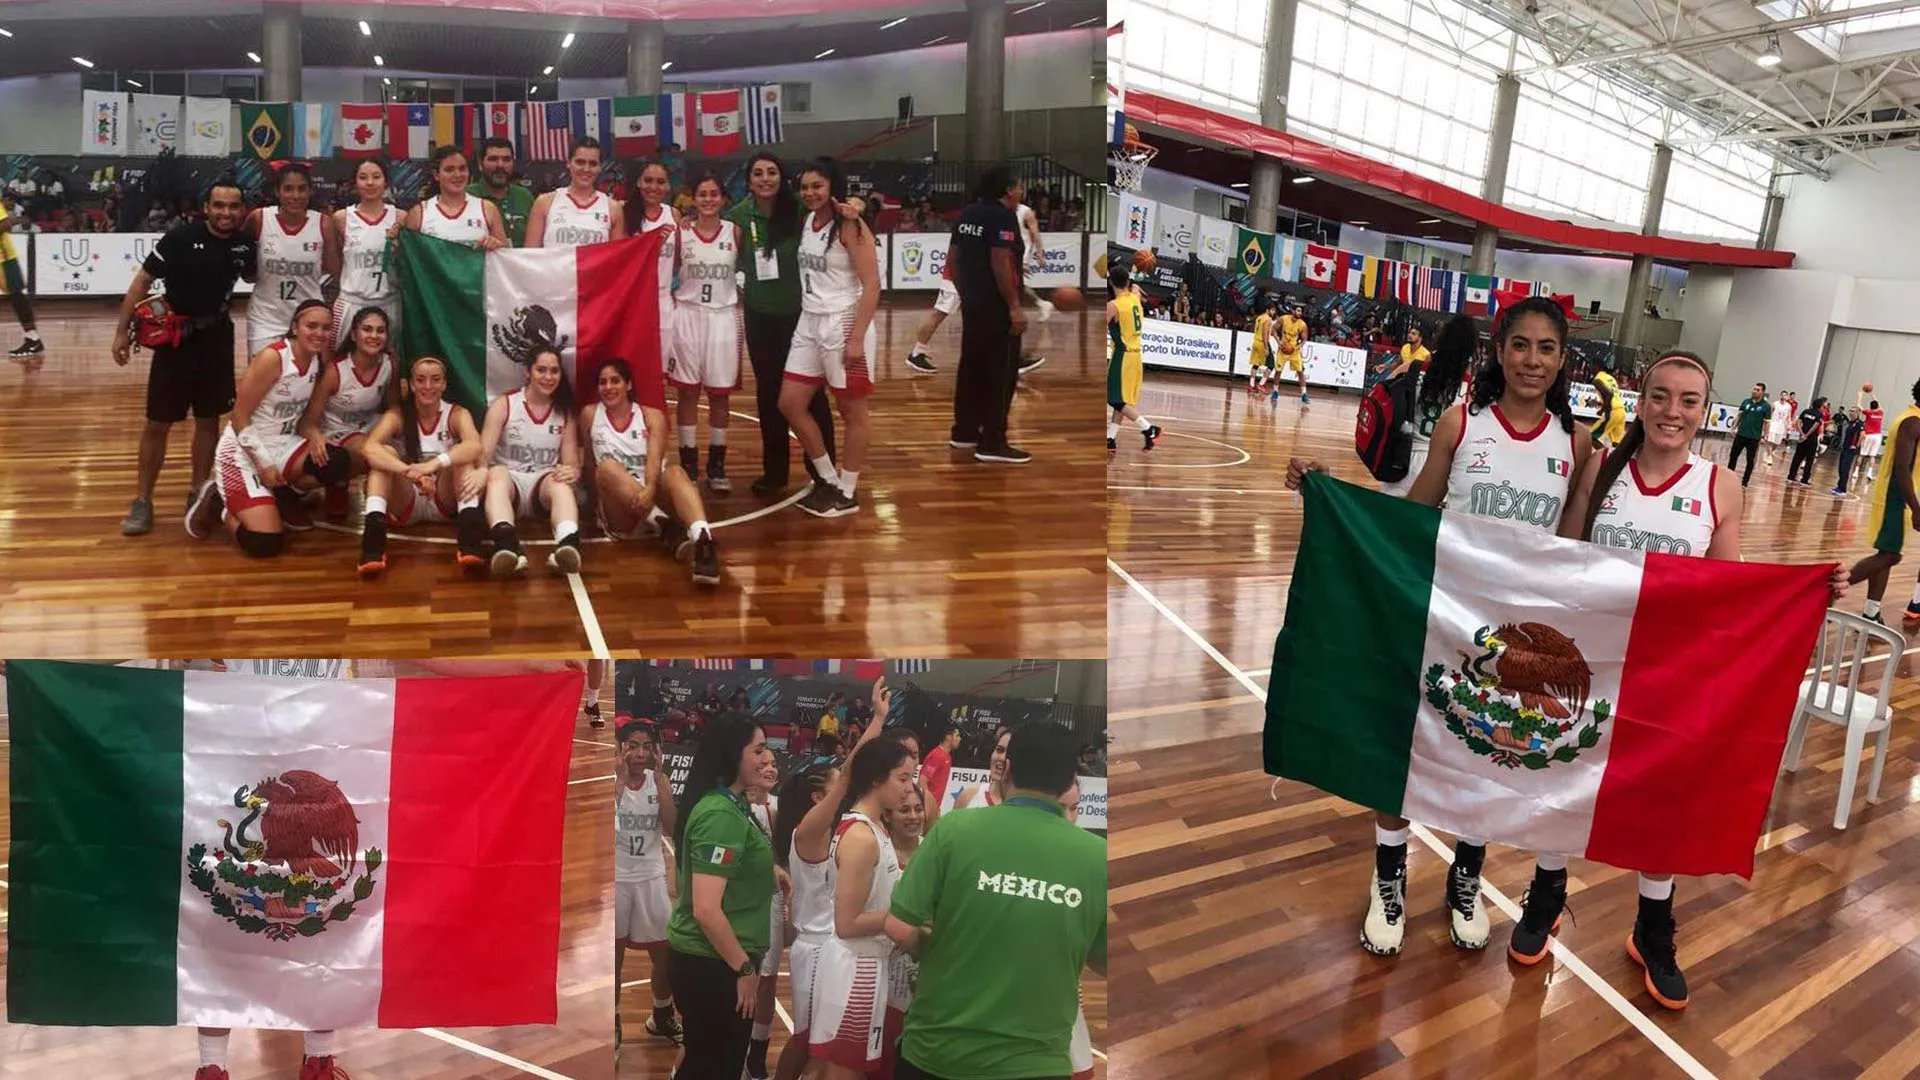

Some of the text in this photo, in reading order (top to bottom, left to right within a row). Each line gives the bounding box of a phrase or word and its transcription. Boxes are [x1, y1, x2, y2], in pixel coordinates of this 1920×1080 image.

[63, 282, 89, 292] FISU
[280, 281, 296, 300] 12
[372, 271, 382, 292] 7
[701, 284, 712, 303] 9
[1176, 335, 1220, 350] Brasileira
[1471, 480, 1561, 528] MÉXICO
[1593, 521, 1692, 556] MÉXICO
[951, 771, 978, 783] FISU
[1085, 804, 1107, 819] Des
[629, 836, 646, 857] 12
[977, 870, 1083, 908] MÉXICO
[872, 1026, 882, 1050] 7
